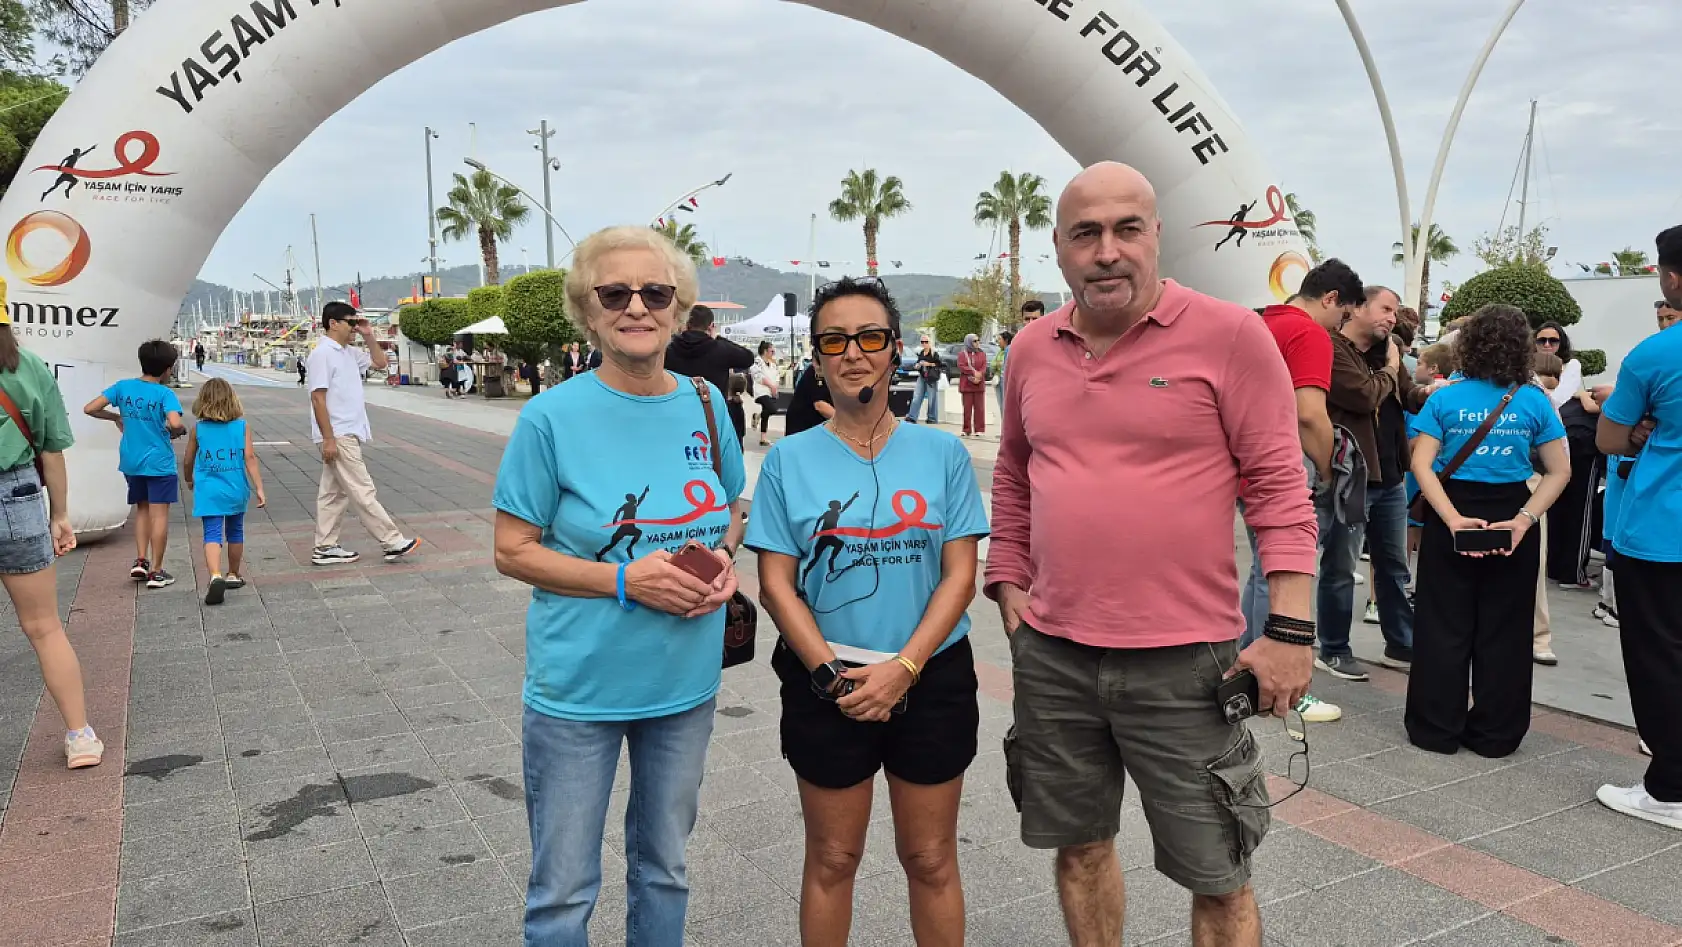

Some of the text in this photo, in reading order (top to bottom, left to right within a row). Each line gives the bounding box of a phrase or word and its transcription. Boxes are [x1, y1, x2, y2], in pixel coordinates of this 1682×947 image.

[156, 0, 298, 113] YAŞAM
[1079, 10, 1229, 165] FOR LIFE
[84, 181, 183, 197] YAŞAM İÇİN YARIŞ
[5, 301, 120, 328] nmez
[12, 326, 74, 338] GROUP
[1459, 408, 1517, 426] Fethye
[1475, 445, 1514, 455] 016
[646, 530, 683, 545] YAŞAM
[685, 525, 707, 539] İÇİN
[845, 542, 878, 554] YAŞAM
[881, 539, 901, 552] İÇİN
[882, 556, 903, 565] FOR
